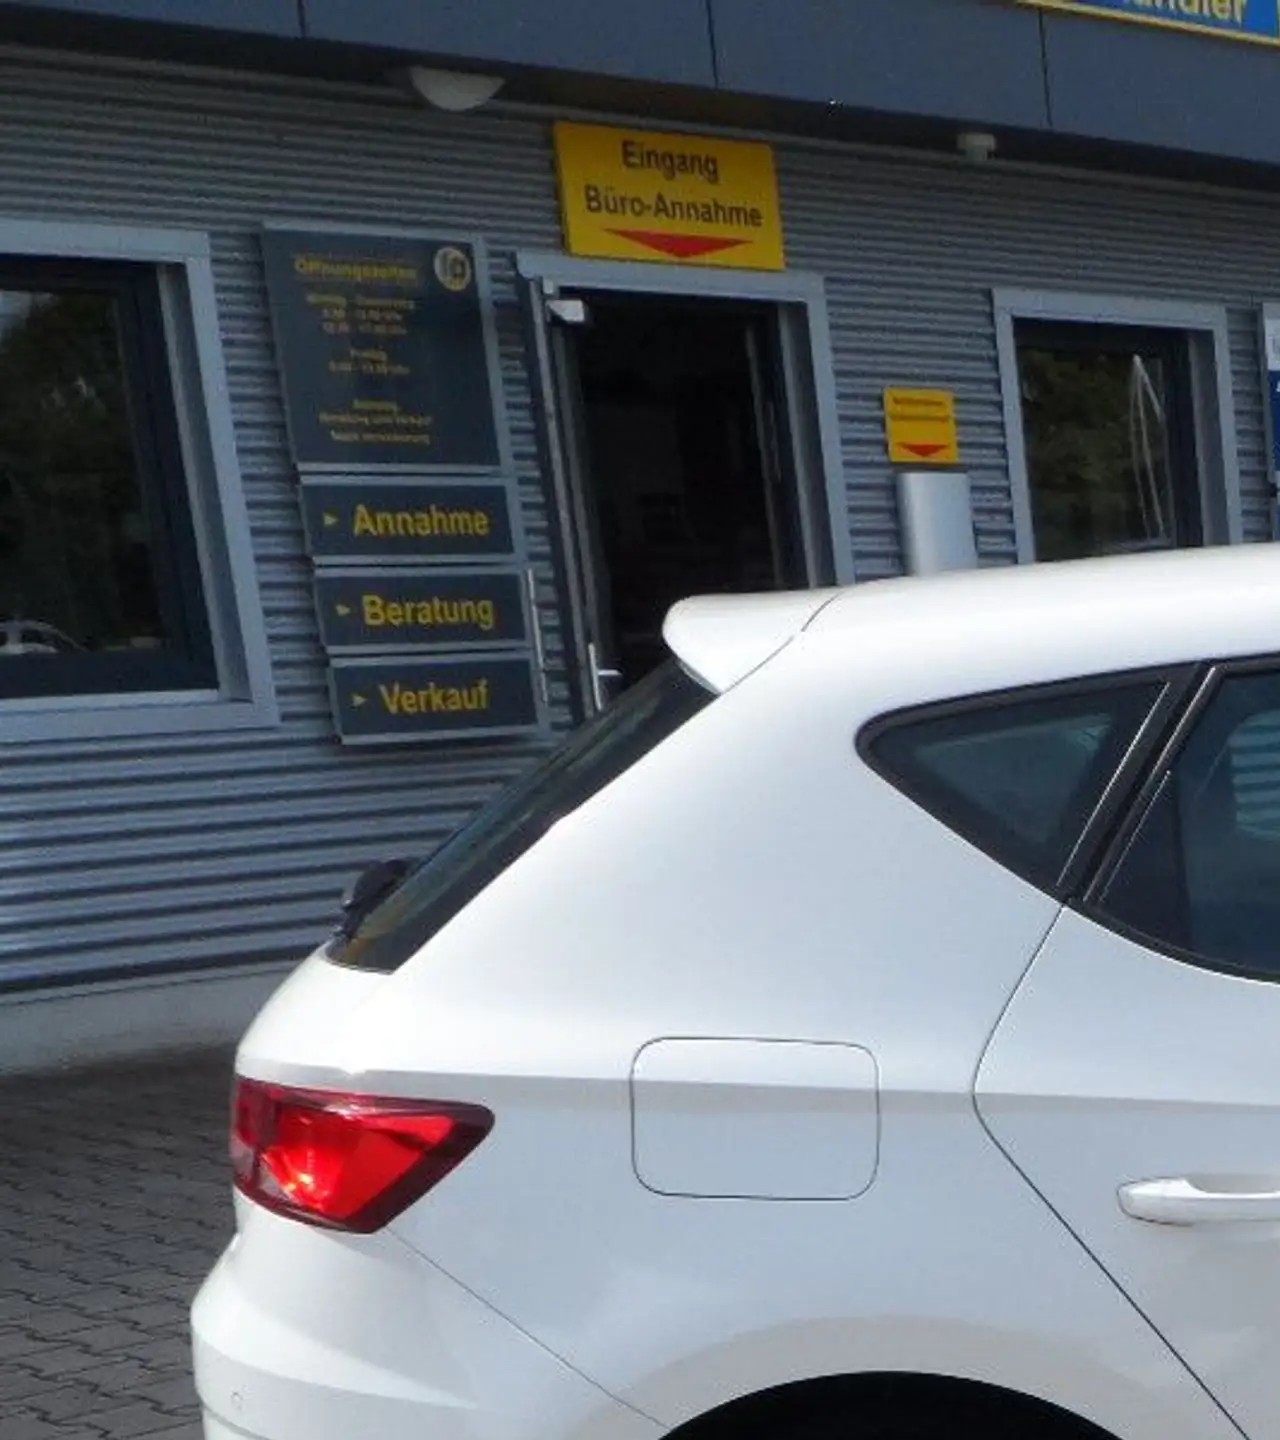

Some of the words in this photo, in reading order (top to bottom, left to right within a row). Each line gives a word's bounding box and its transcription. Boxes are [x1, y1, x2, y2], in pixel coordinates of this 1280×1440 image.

[622, 139, 720, 185] Eingang
[584, 182, 764, 227] Büro-Annahme
[354, 503, 490, 537] Annahme
[362, 594, 495, 631] Beratung
[378, 677, 489, 715] Verkauf
